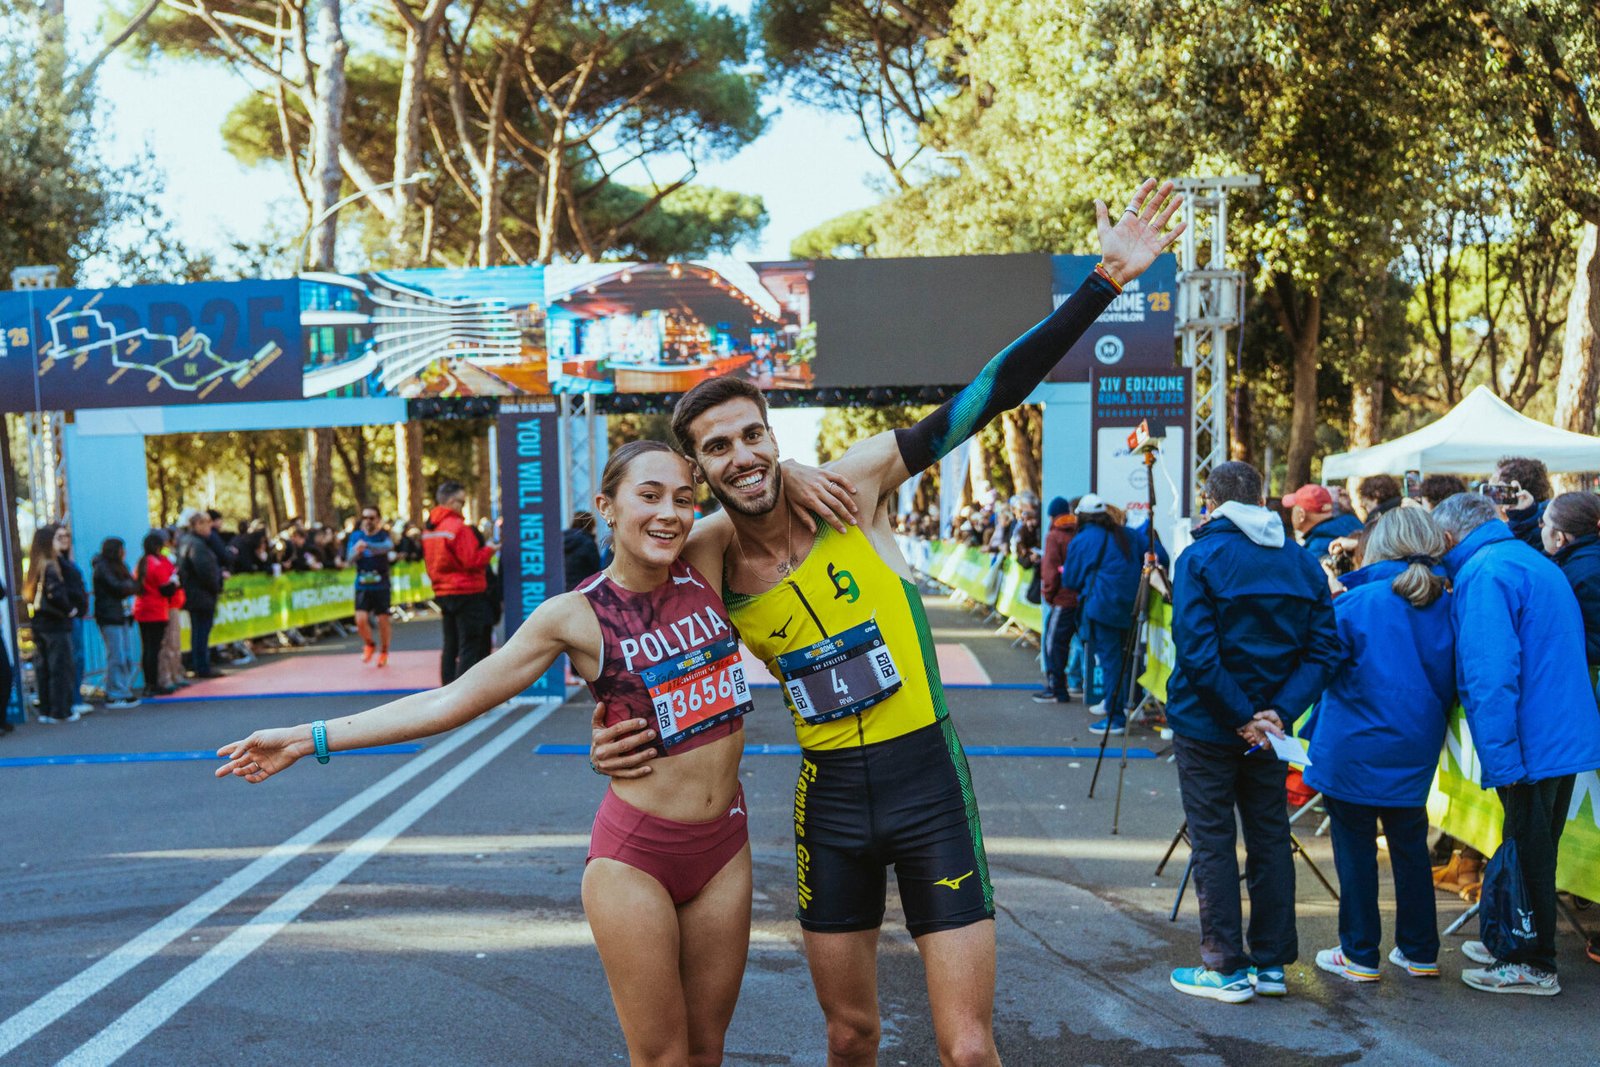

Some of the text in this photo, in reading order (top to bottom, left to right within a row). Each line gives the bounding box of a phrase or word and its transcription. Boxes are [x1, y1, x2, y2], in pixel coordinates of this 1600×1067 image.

[1099, 376, 1185, 392] XIV EDIZIONE
[516, 418, 541, 457] YOU
[517, 461, 544, 510] WILL
[519, 513, 545, 577] NEVER
[620, 606, 728, 671] POLIZIA
[672, 670, 732, 718] 3656
[830, 668, 849, 695] 4
[838, 695, 855, 706] RIVA
[793, 757, 817, 910] Fiamme Gialle
